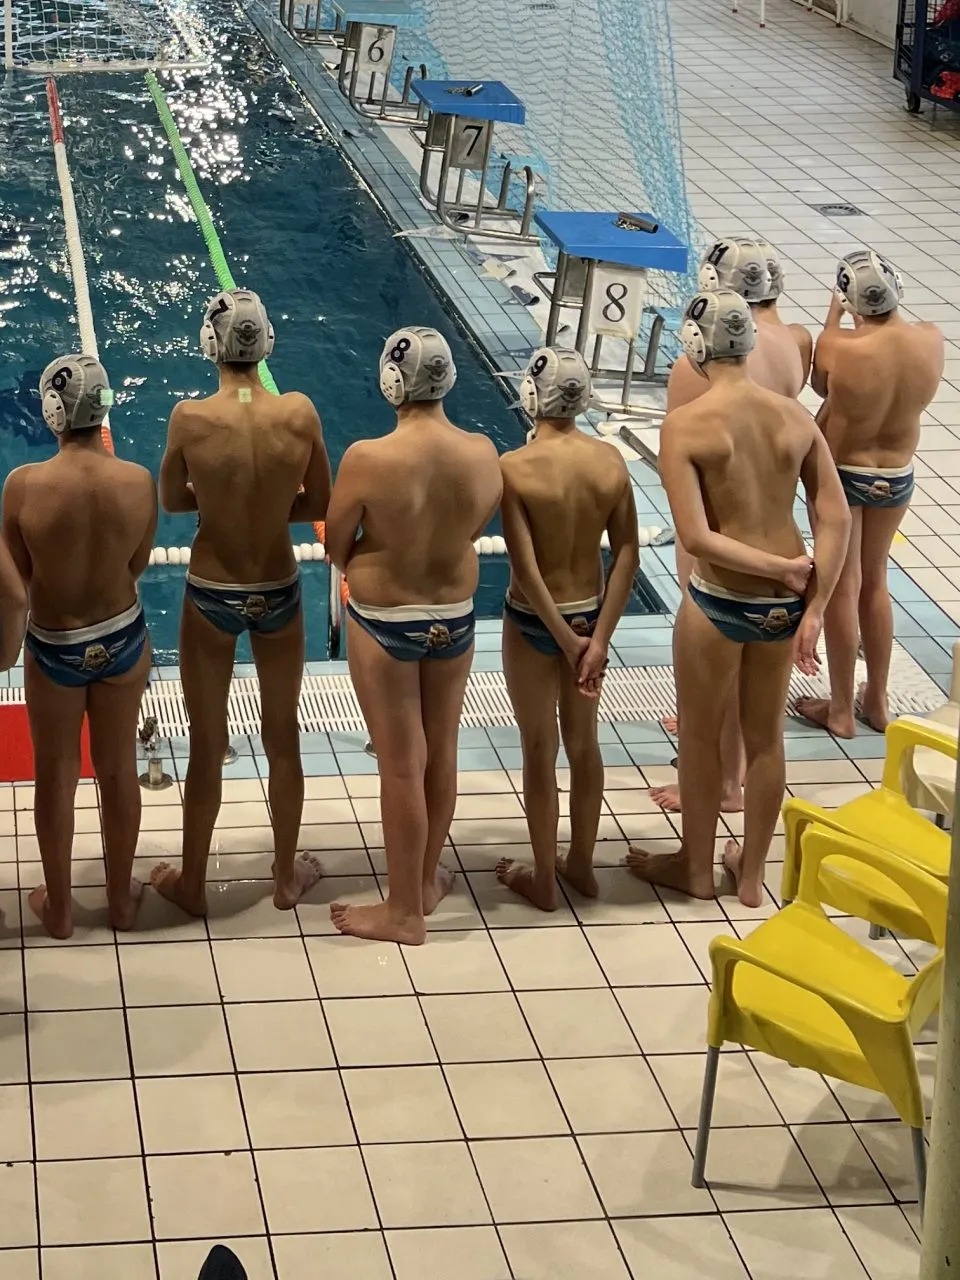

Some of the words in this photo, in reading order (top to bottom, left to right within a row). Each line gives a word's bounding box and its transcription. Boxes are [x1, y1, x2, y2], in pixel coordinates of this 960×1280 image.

[367, 38, 385, 63] 6
[462, 125, 483, 156] 7
[708, 243, 729, 266] 11
[210, 298, 229, 321] 7
[602, 283, 628, 322] 8
[391, 338, 411, 363] 8
[52, 366, 73, 391] 6
[531, 355, 548, 377] 9
